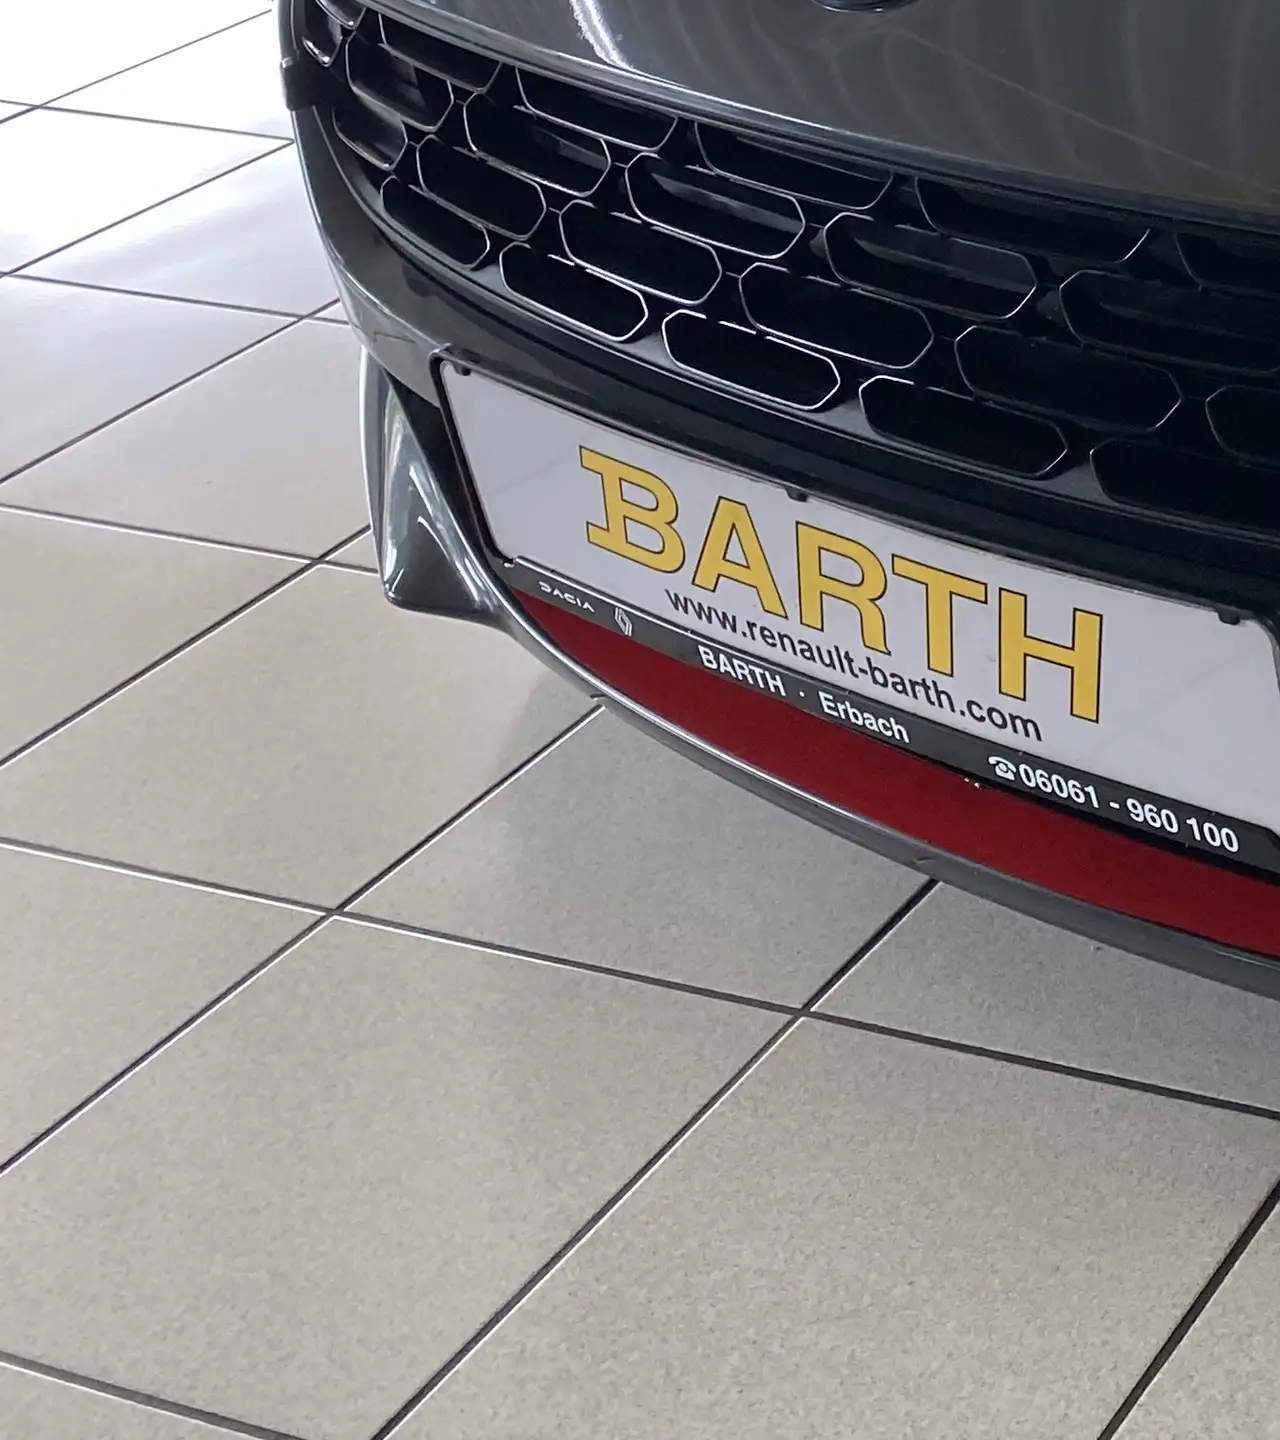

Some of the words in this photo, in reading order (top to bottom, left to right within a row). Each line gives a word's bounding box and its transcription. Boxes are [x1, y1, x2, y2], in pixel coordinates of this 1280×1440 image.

[538, 580, 595, 613] DACIA
[579, 444, 1103, 724] BARTH
[664, 588, 1043, 742] www.renault-barth.com
[697, 644, 787, 697] BARTH
[818, 691, 911, 743] Erbach
[1018, 763, 1100, 809] 06061
[1126, 798, 1179, 834] 960
[1186, 817, 1240, 853] 100
